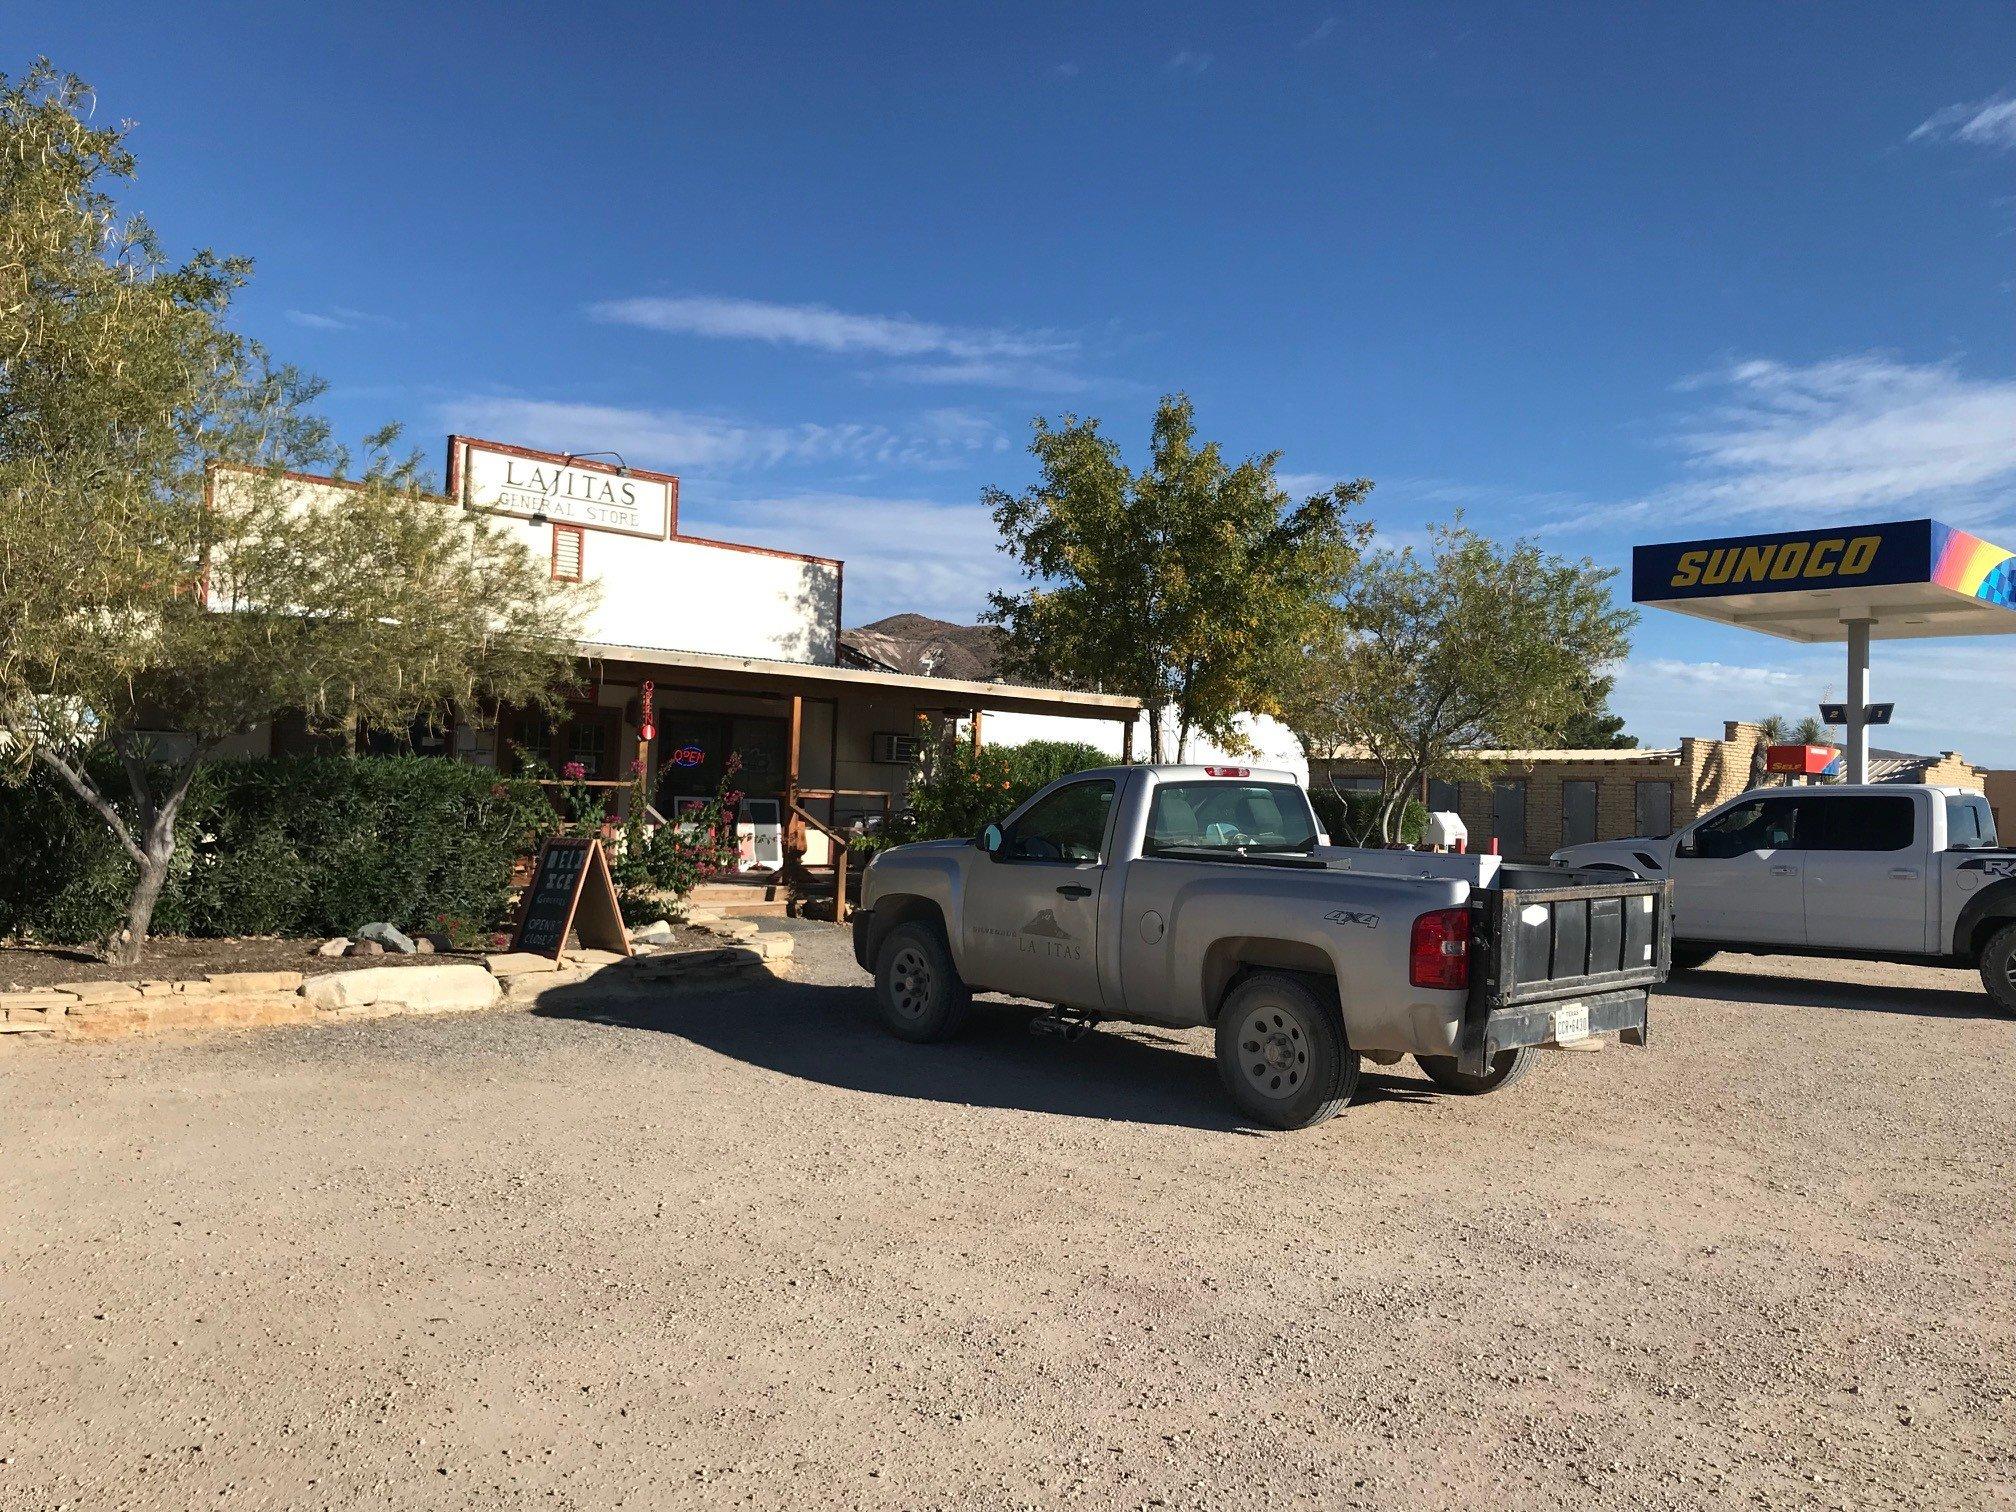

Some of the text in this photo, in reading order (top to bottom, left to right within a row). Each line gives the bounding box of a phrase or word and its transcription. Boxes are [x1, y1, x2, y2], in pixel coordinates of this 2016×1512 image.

[506, 461, 636, 506] LAJITAS
[500, 492, 639, 527] GENERAL STORE
[1670, 535, 1883, 588] SUNOCO
[674, 749, 705, 764] OPEN
